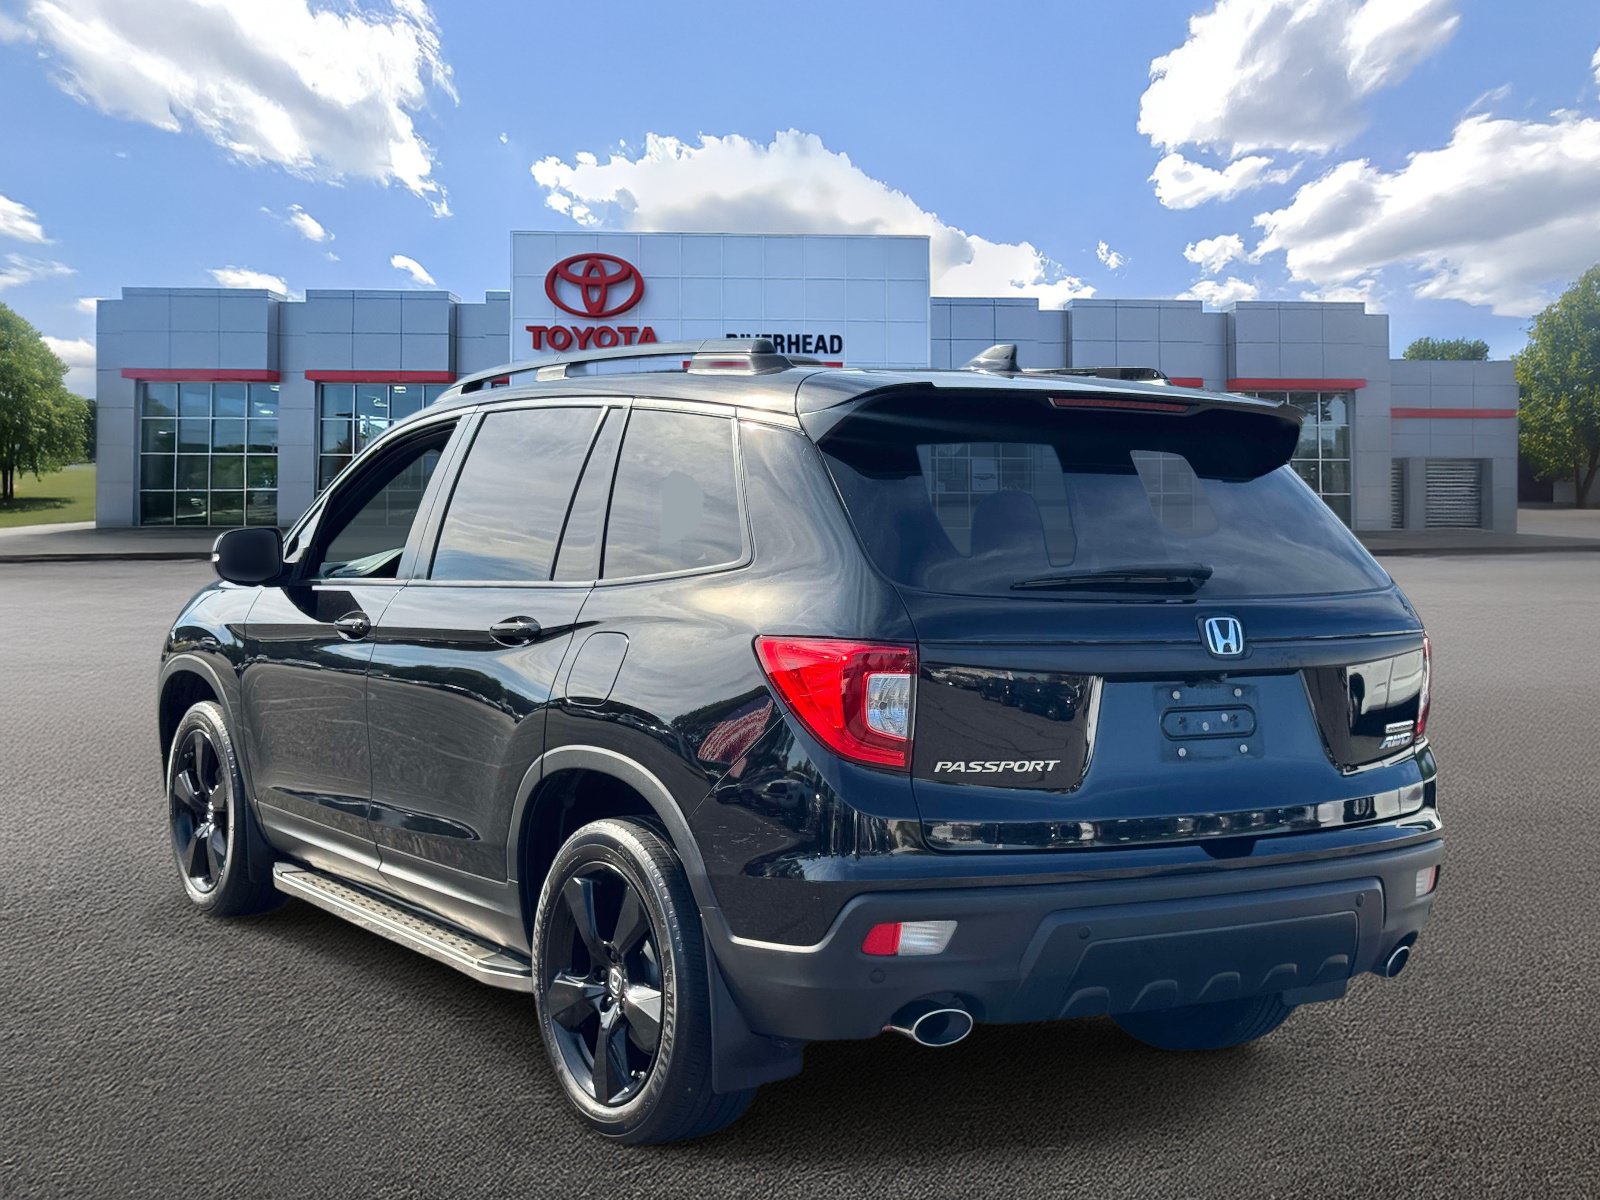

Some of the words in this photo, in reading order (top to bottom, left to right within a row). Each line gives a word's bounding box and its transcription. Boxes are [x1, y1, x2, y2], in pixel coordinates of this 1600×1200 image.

[526, 325, 658, 351] TOYOTA
[726, 333, 843, 354] RHEAD
[934, 760, 1061, 773] PASSPORT
